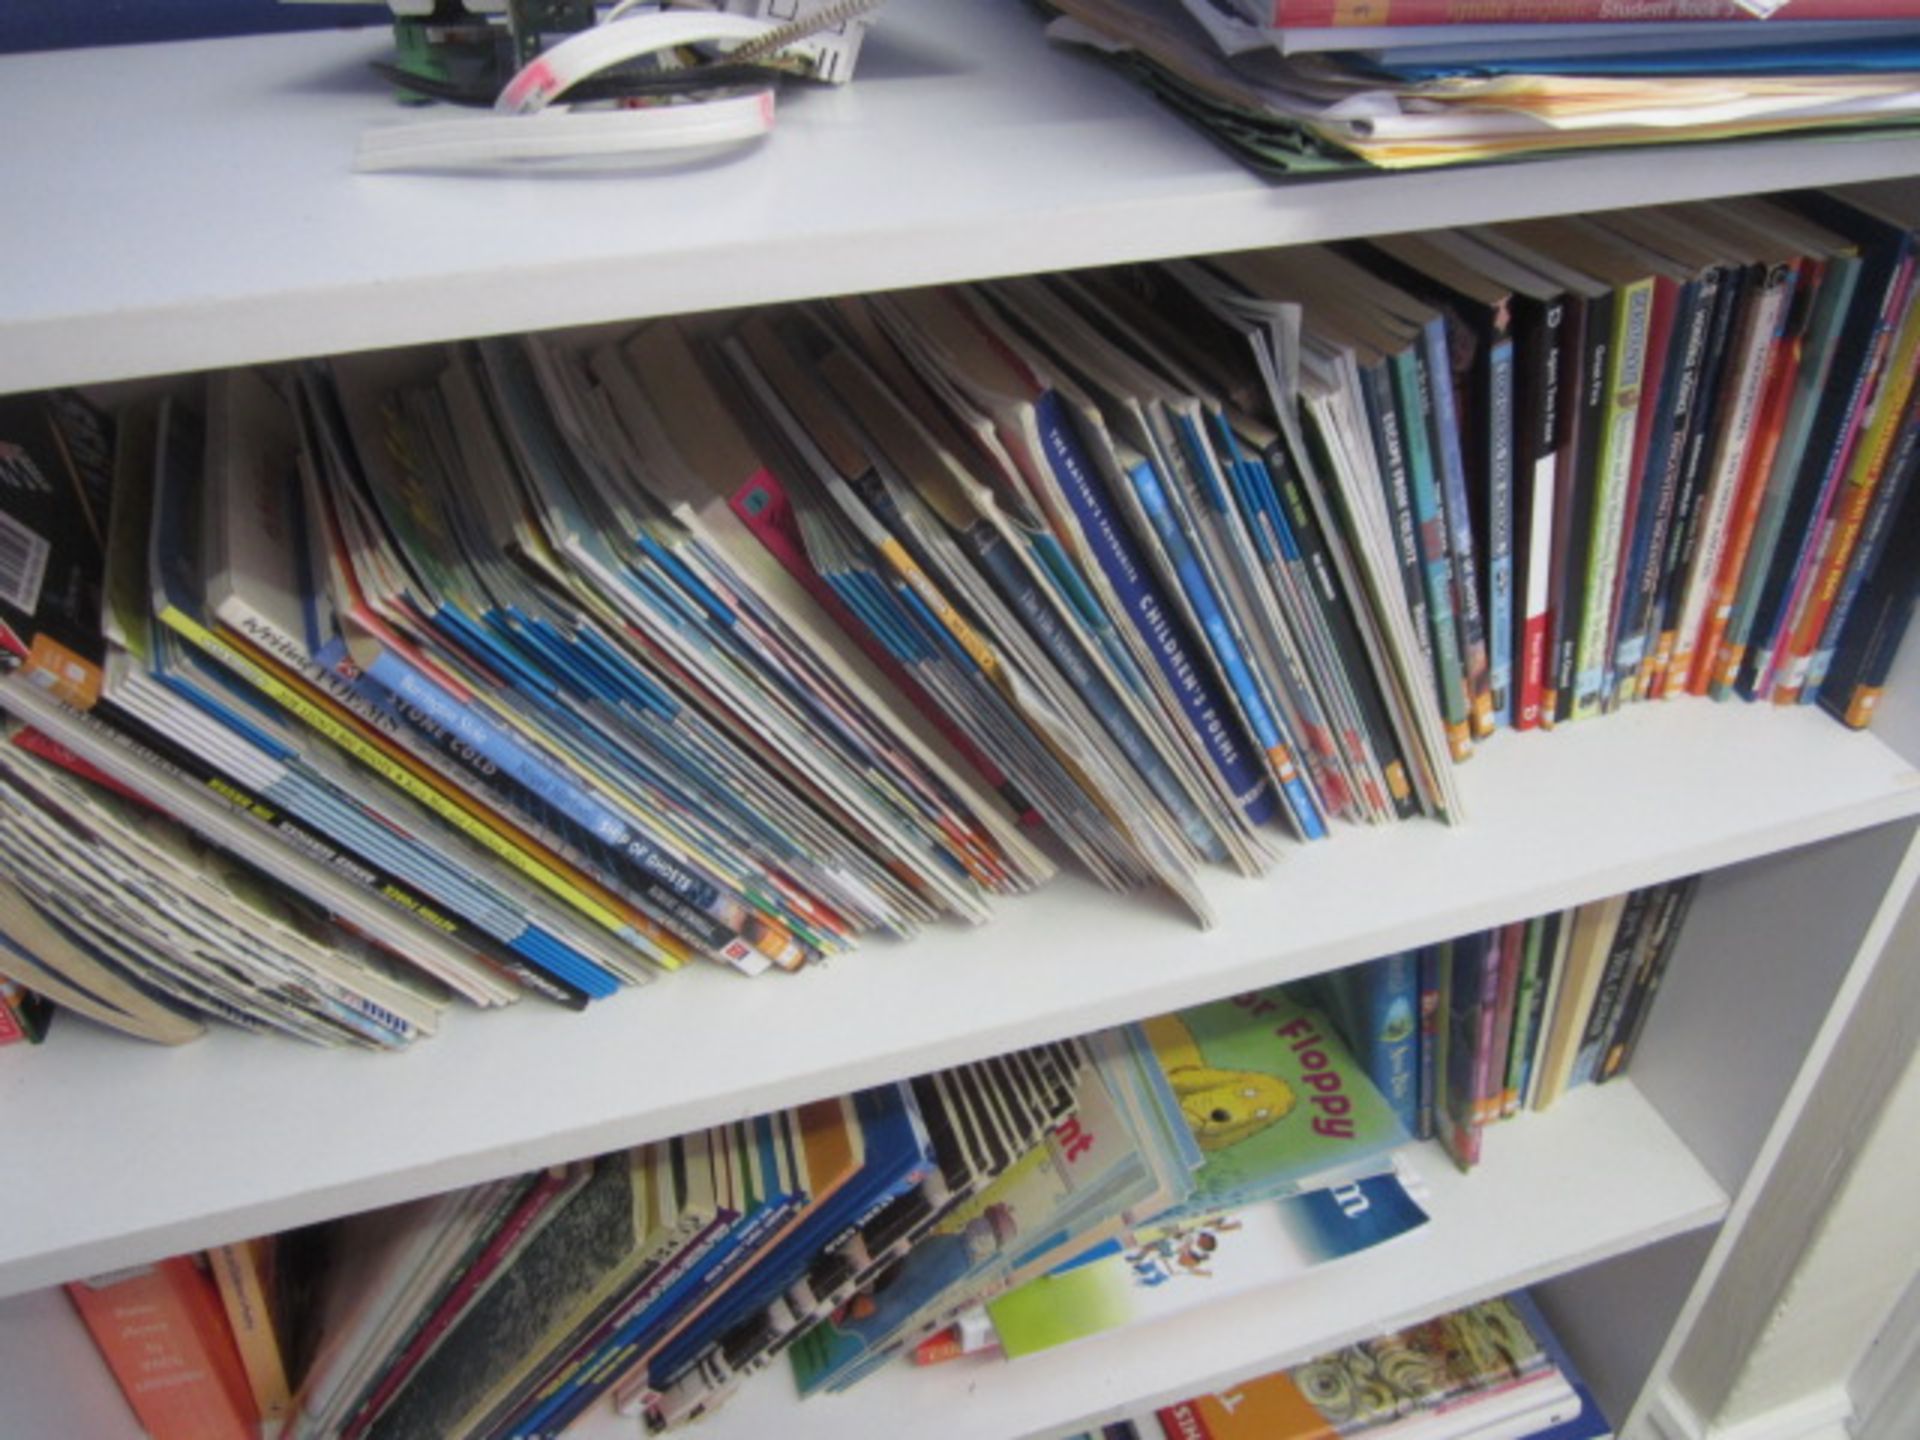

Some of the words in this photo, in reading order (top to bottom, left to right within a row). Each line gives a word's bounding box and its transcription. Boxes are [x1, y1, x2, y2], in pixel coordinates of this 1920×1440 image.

[1598, 1, 1672, 18] Student
[1677, 1, 1720, 17] Book
[1376, 410, 1406, 468] ESCAPE
[1046, 427, 1069, 456] THE
[1062, 455, 1103, 518] NATION'S
[1096, 517, 1140, 584] FAVOURITE
[1135, 593, 1207, 707] CHILDREN'S
[1198, 707, 1240, 766] POEMS
[236, 611, 320, 678] Writing
[310, 663, 404, 736] POEMS
[383, 690, 449, 743] STONE
[441, 730, 501, 778] COLD
[596, 816, 632, 848] SHIP
[626, 839, 648, 860] OF
[643, 851, 694, 894] GHOSTS
[1276, 1016, 1355, 1139] Floppy
[1055, 1115, 1095, 1163] nt
